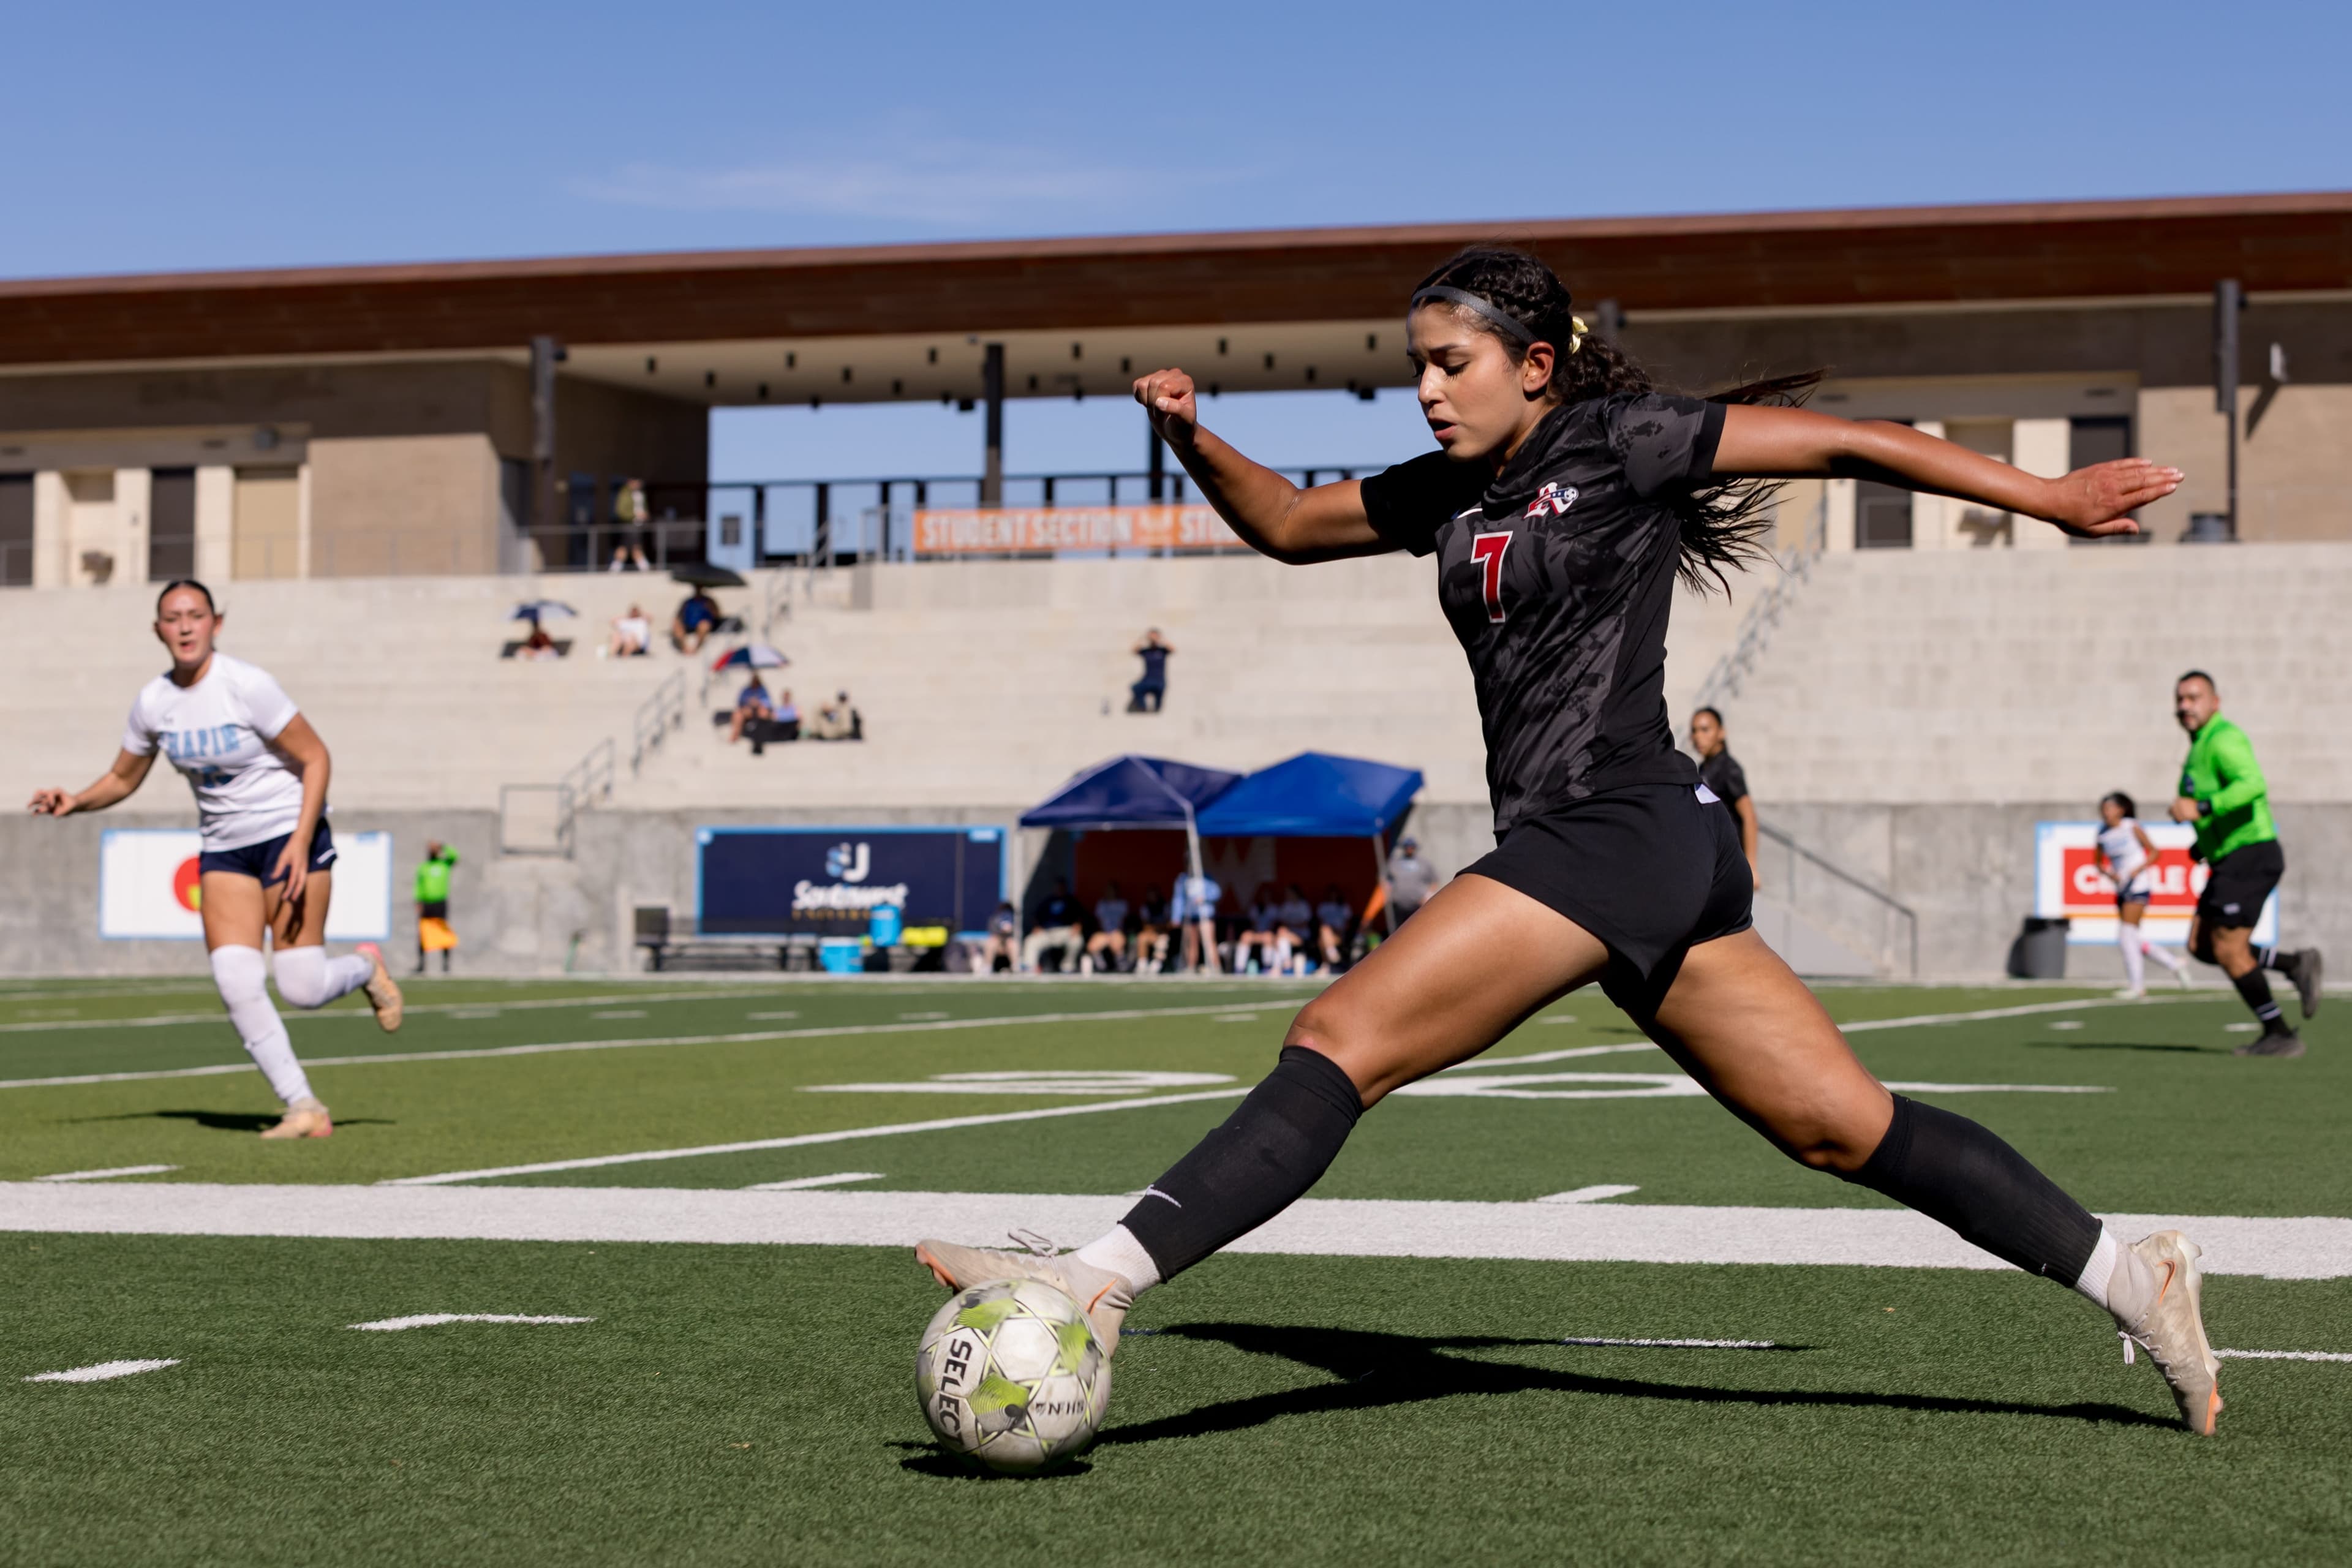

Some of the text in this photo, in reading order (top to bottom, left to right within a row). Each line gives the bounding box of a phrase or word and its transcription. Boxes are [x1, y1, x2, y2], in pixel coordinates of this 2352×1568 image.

[922, 514, 1027, 548] STUDENT
[1031, 512, 1133, 545] SECTION
[1470, 530, 1513, 624] 7
